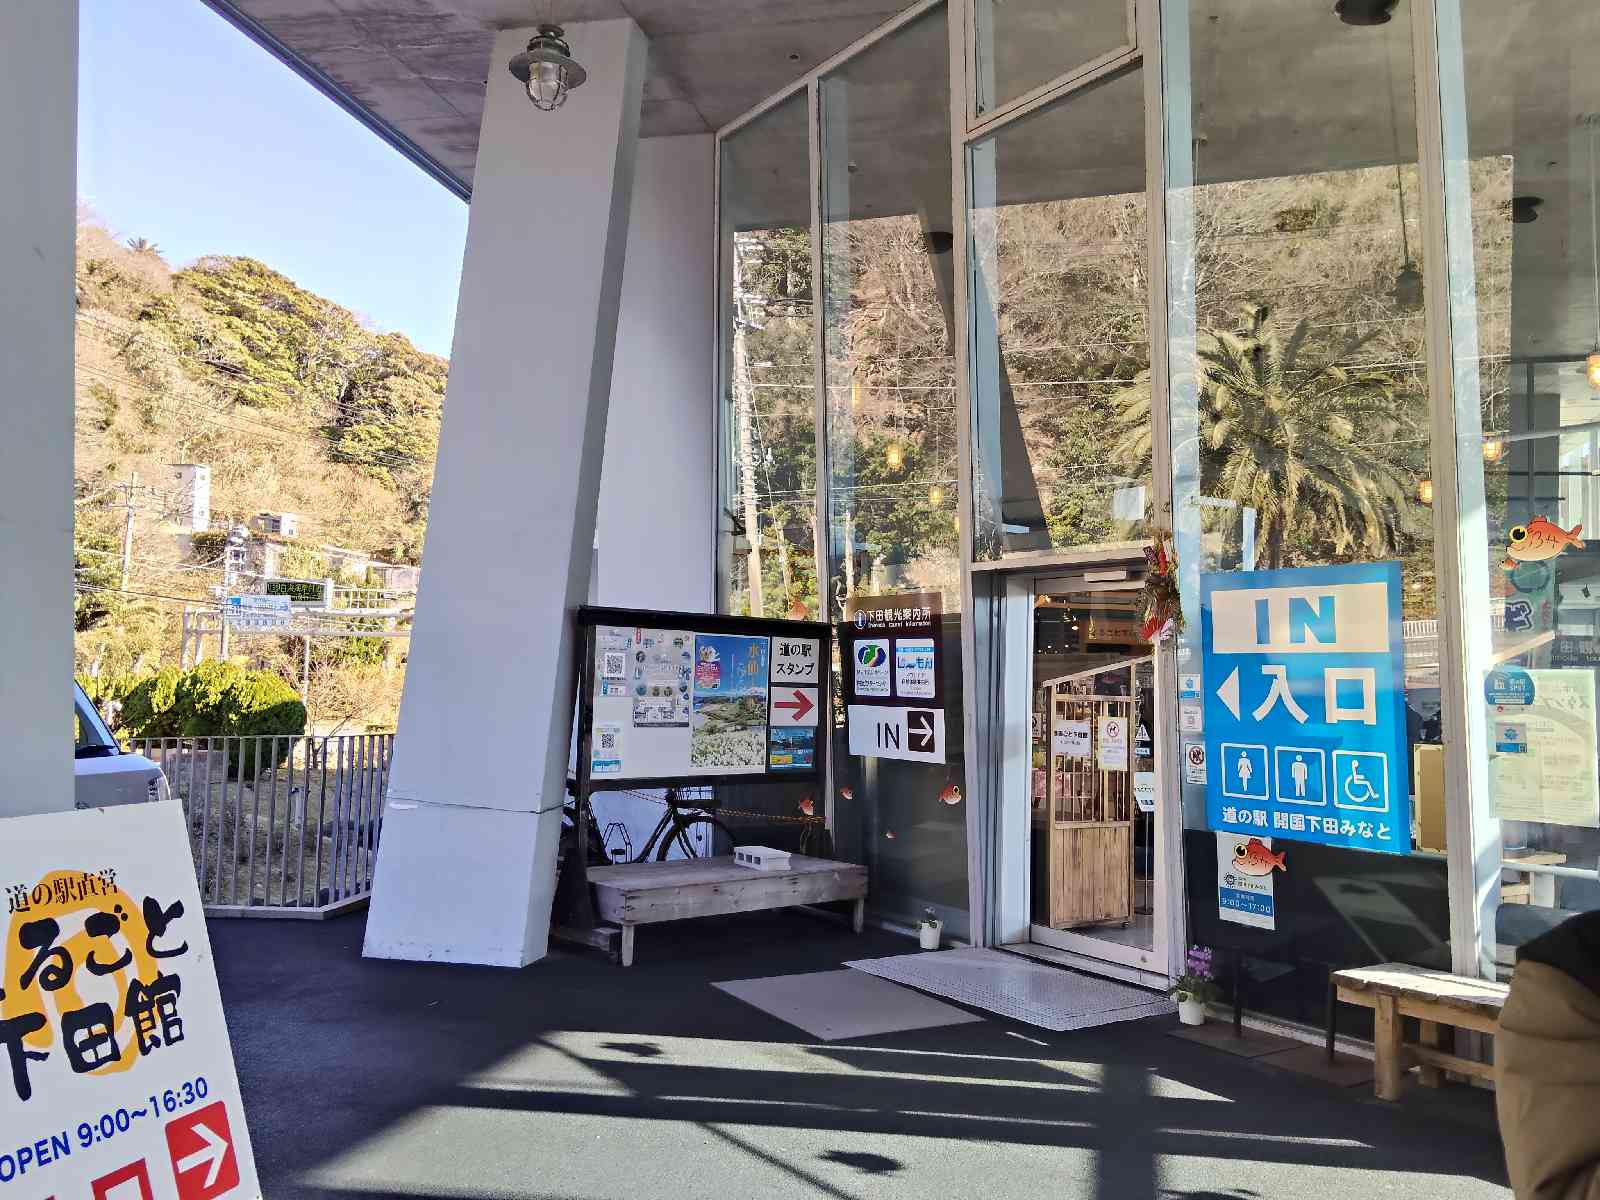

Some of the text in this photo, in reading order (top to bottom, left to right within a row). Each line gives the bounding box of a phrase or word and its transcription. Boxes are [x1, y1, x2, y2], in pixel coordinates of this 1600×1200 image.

[866, 606, 931, 621] 下田観光案内所
[1255, 595, 1337, 645] IN
[776, 662, 815, 677] スタンプ
[779, 643, 812, 657] 道の駅
[1252, 664, 1377, 726] 入口
[877, 722, 900, 750] IN
[1222, 807, 1392, 840] 道の駅 開国下田みなと
[5, 868, 120, 915] 道の駅直営
[0, 895, 189, 991] るごと
[0, 970, 185, 1102] 下田館
[0, 1130, 72, 1183] OPEN
